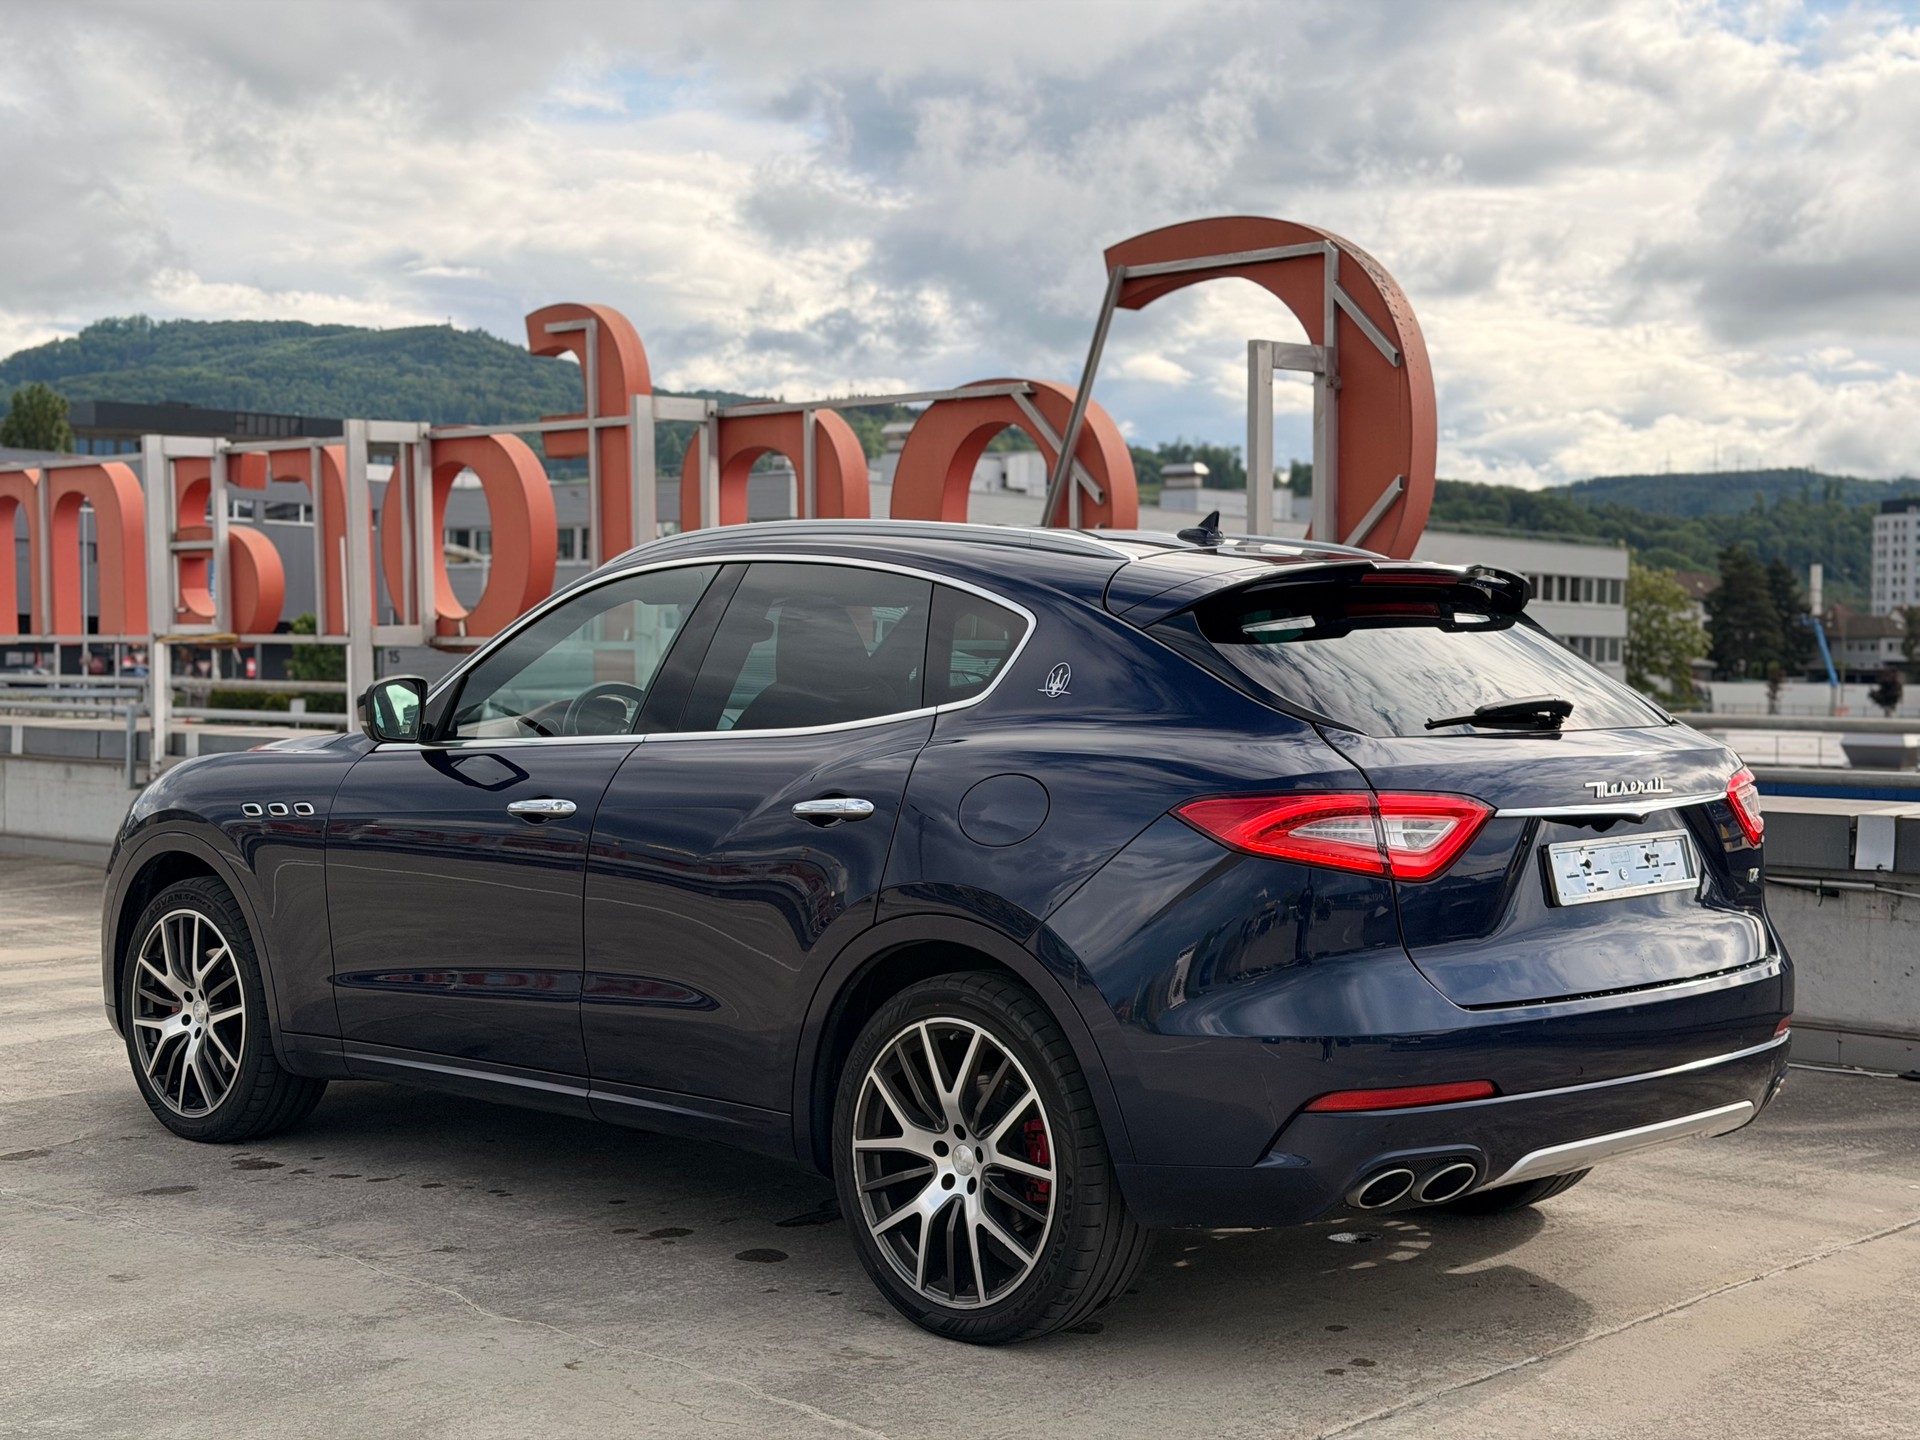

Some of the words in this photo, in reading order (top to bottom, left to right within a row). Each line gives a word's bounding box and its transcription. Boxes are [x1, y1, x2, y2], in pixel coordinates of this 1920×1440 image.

[388, 650, 400, 664] 15
[1584, 776, 1673, 798] Maserati
[148, 892, 183, 919] ADVAN
[845, 1031, 877, 1086] YOKOHAMA
[1049, 1171, 1074, 1266] ADVAN
